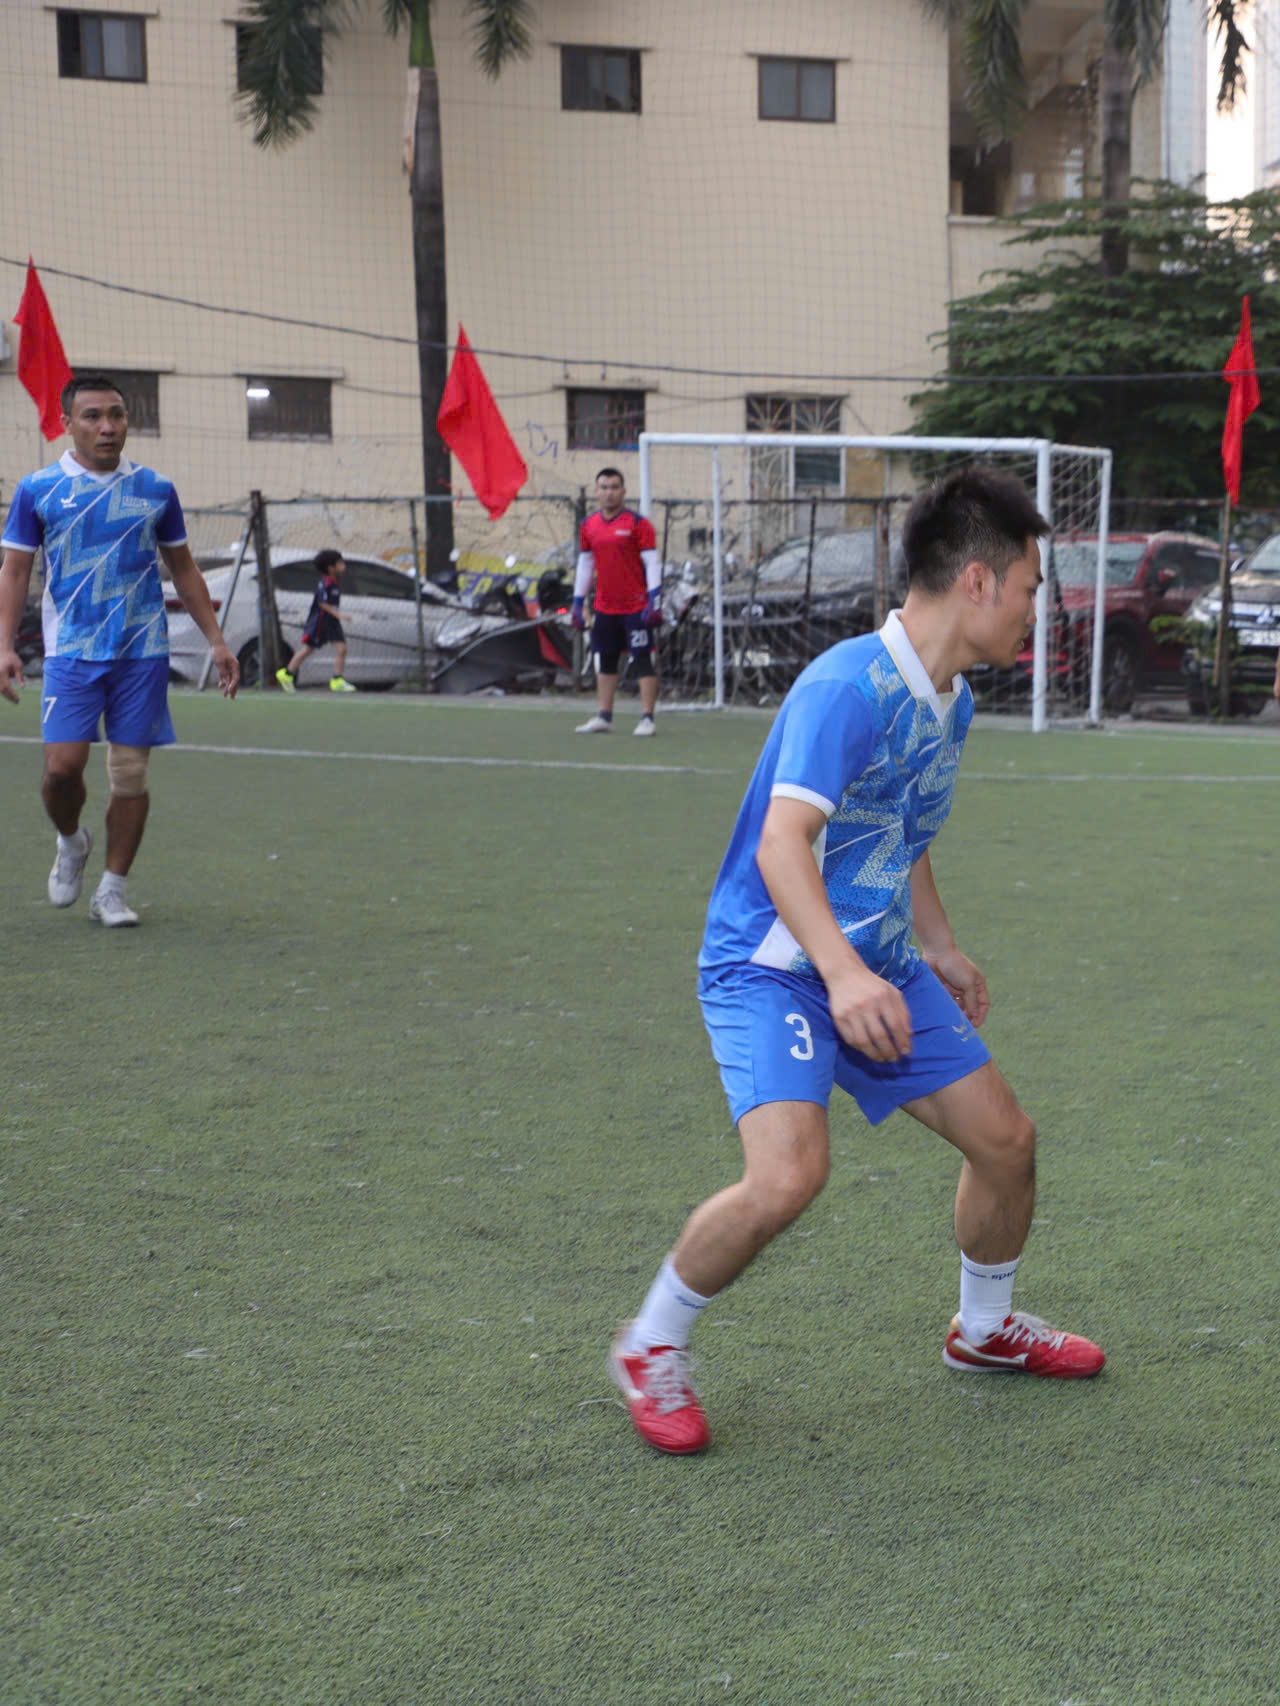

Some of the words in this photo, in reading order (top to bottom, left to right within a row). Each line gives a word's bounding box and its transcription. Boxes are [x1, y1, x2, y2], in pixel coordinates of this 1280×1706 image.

[630, 630, 648, 647] 20
[43, 696, 58, 723] 7
[784, 1012, 814, 1061] 3
